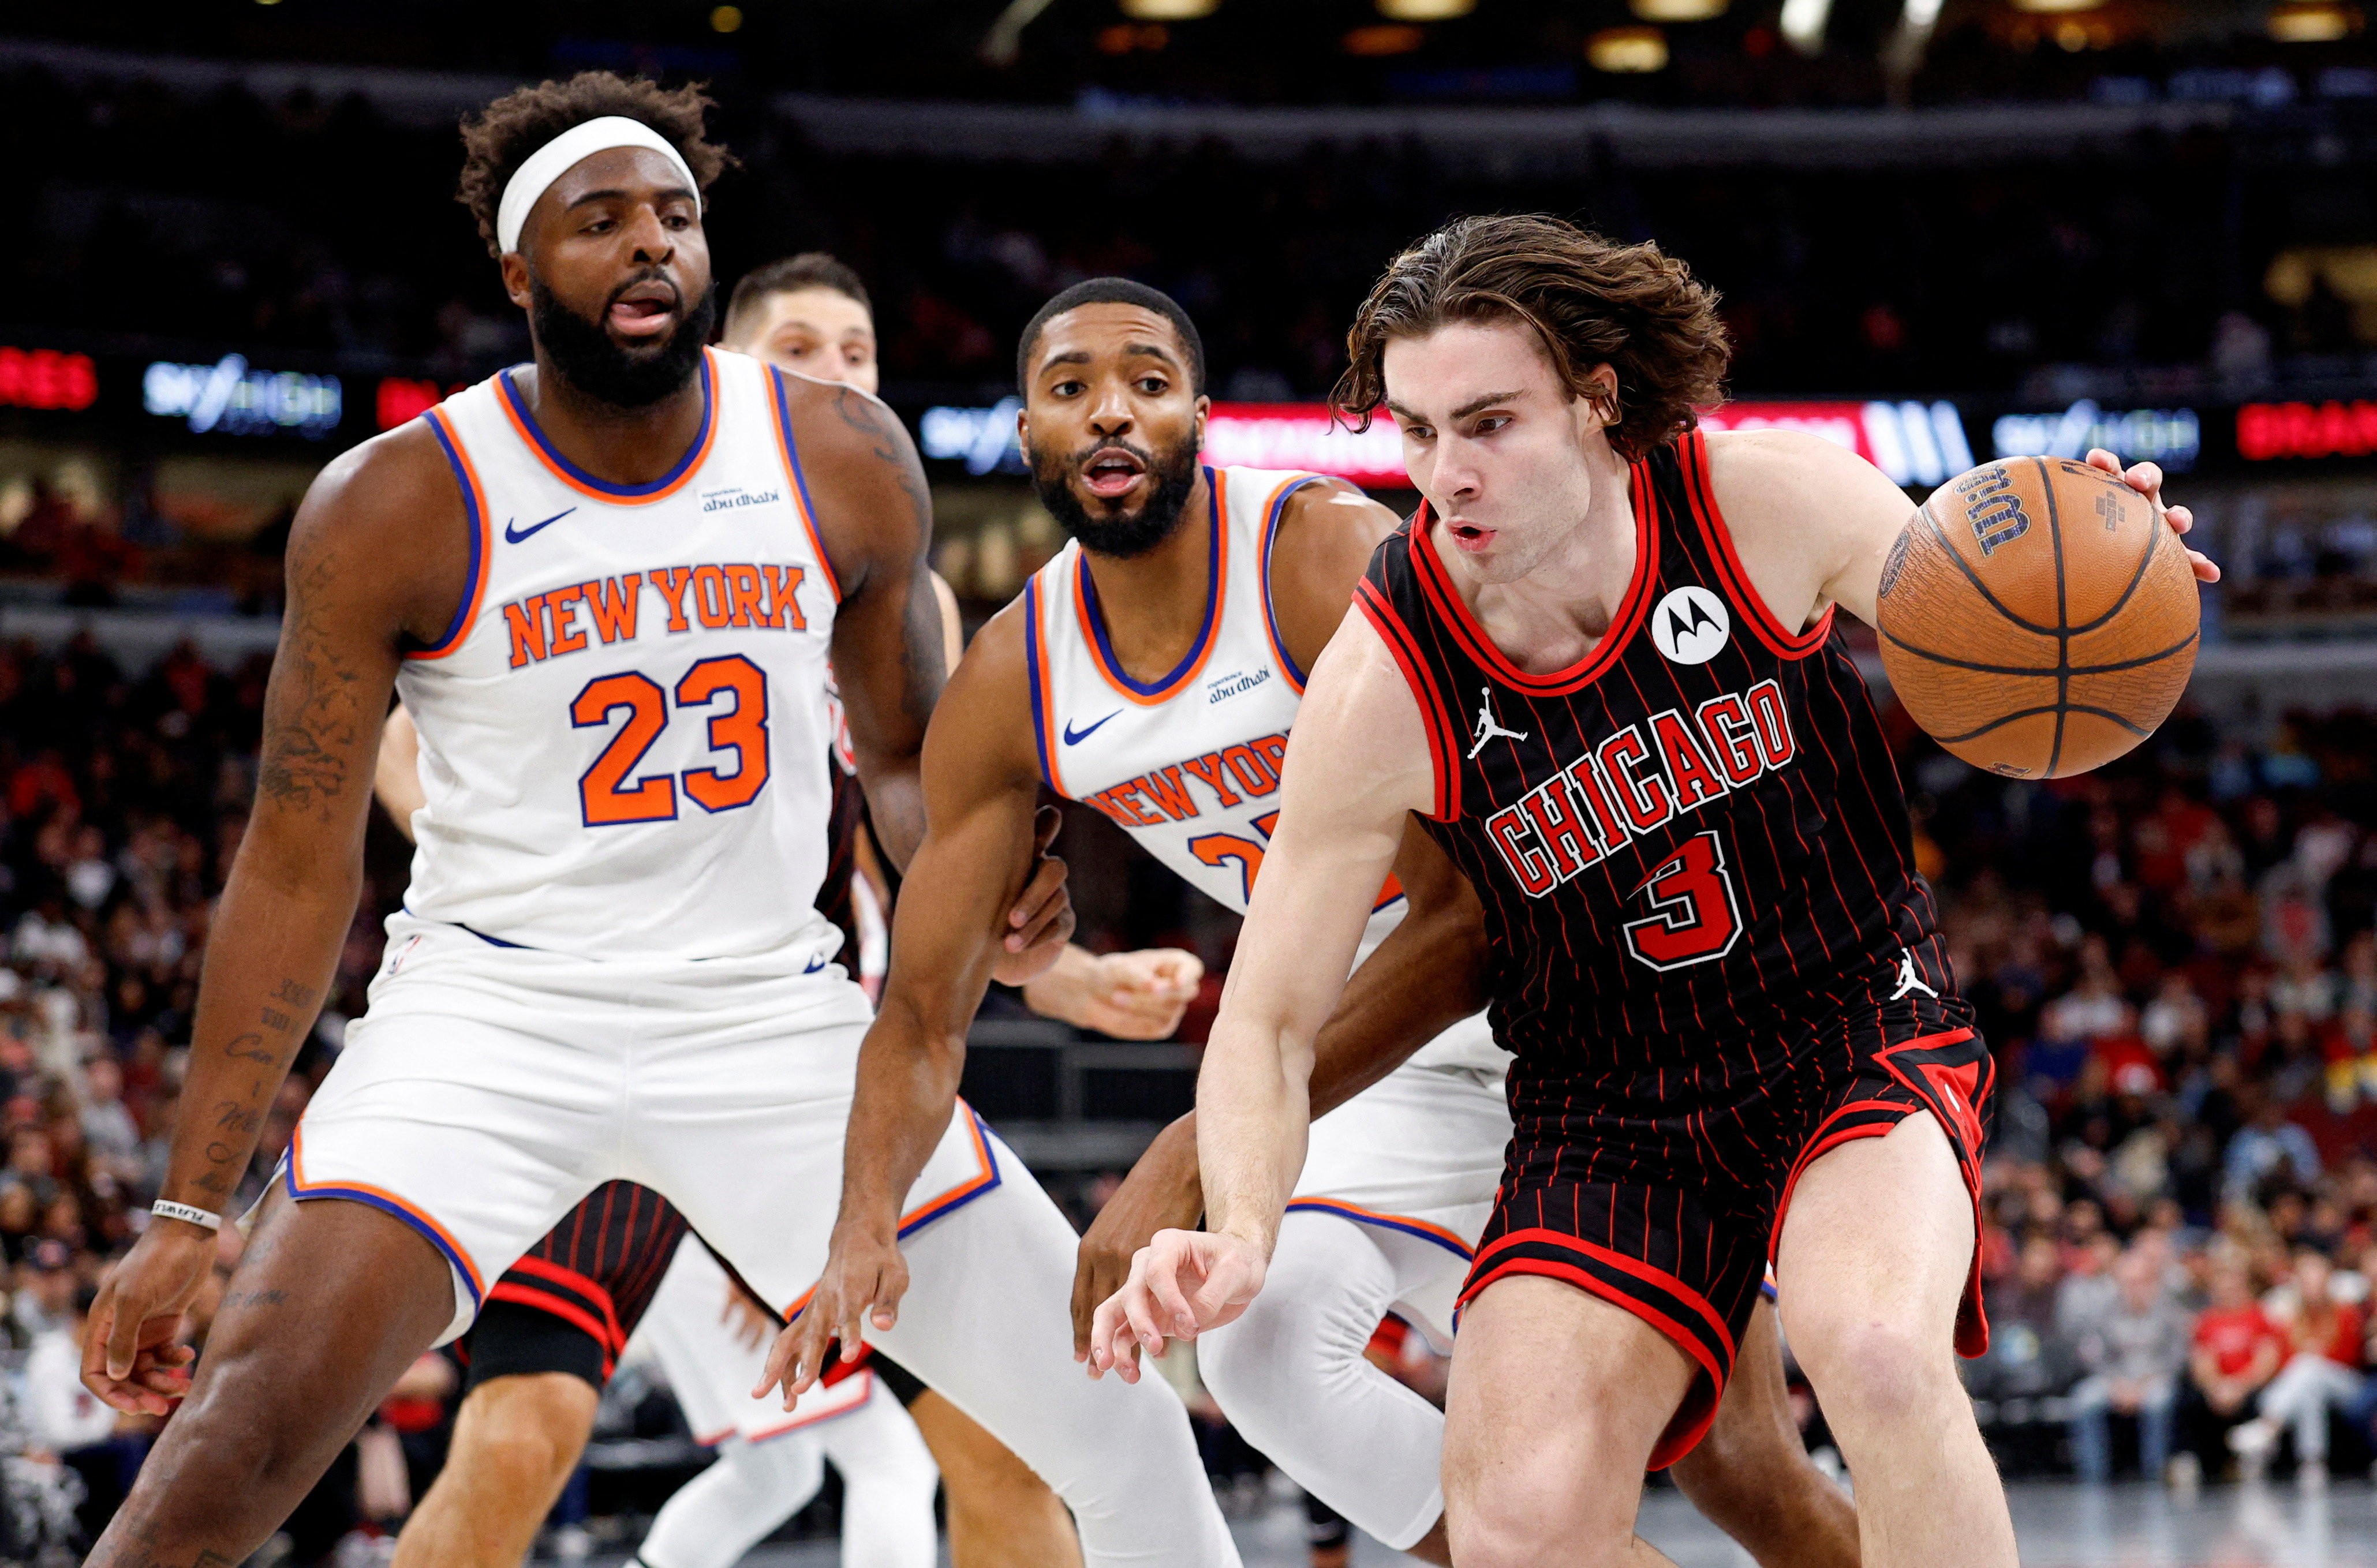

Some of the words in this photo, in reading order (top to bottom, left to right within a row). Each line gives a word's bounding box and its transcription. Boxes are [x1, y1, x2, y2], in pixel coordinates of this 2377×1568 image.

[704, 499, 732, 512] abu
[736, 489, 779, 506] dhabi
[503, 573, 642, 669] NEW
[648, 563, 807, 633] YORK
[1210, 686, 1235, 703] abu
[1237, 665, 1270, 691] dhabi
[570, 653, 771, 828] 23
[1081, 765, 1201, 826] NEW
[1182, 729, 1292, 810] YOR
[1485, 679, 1796, 898] CHICAGO
[1623, 830, 1743, 972] 3
